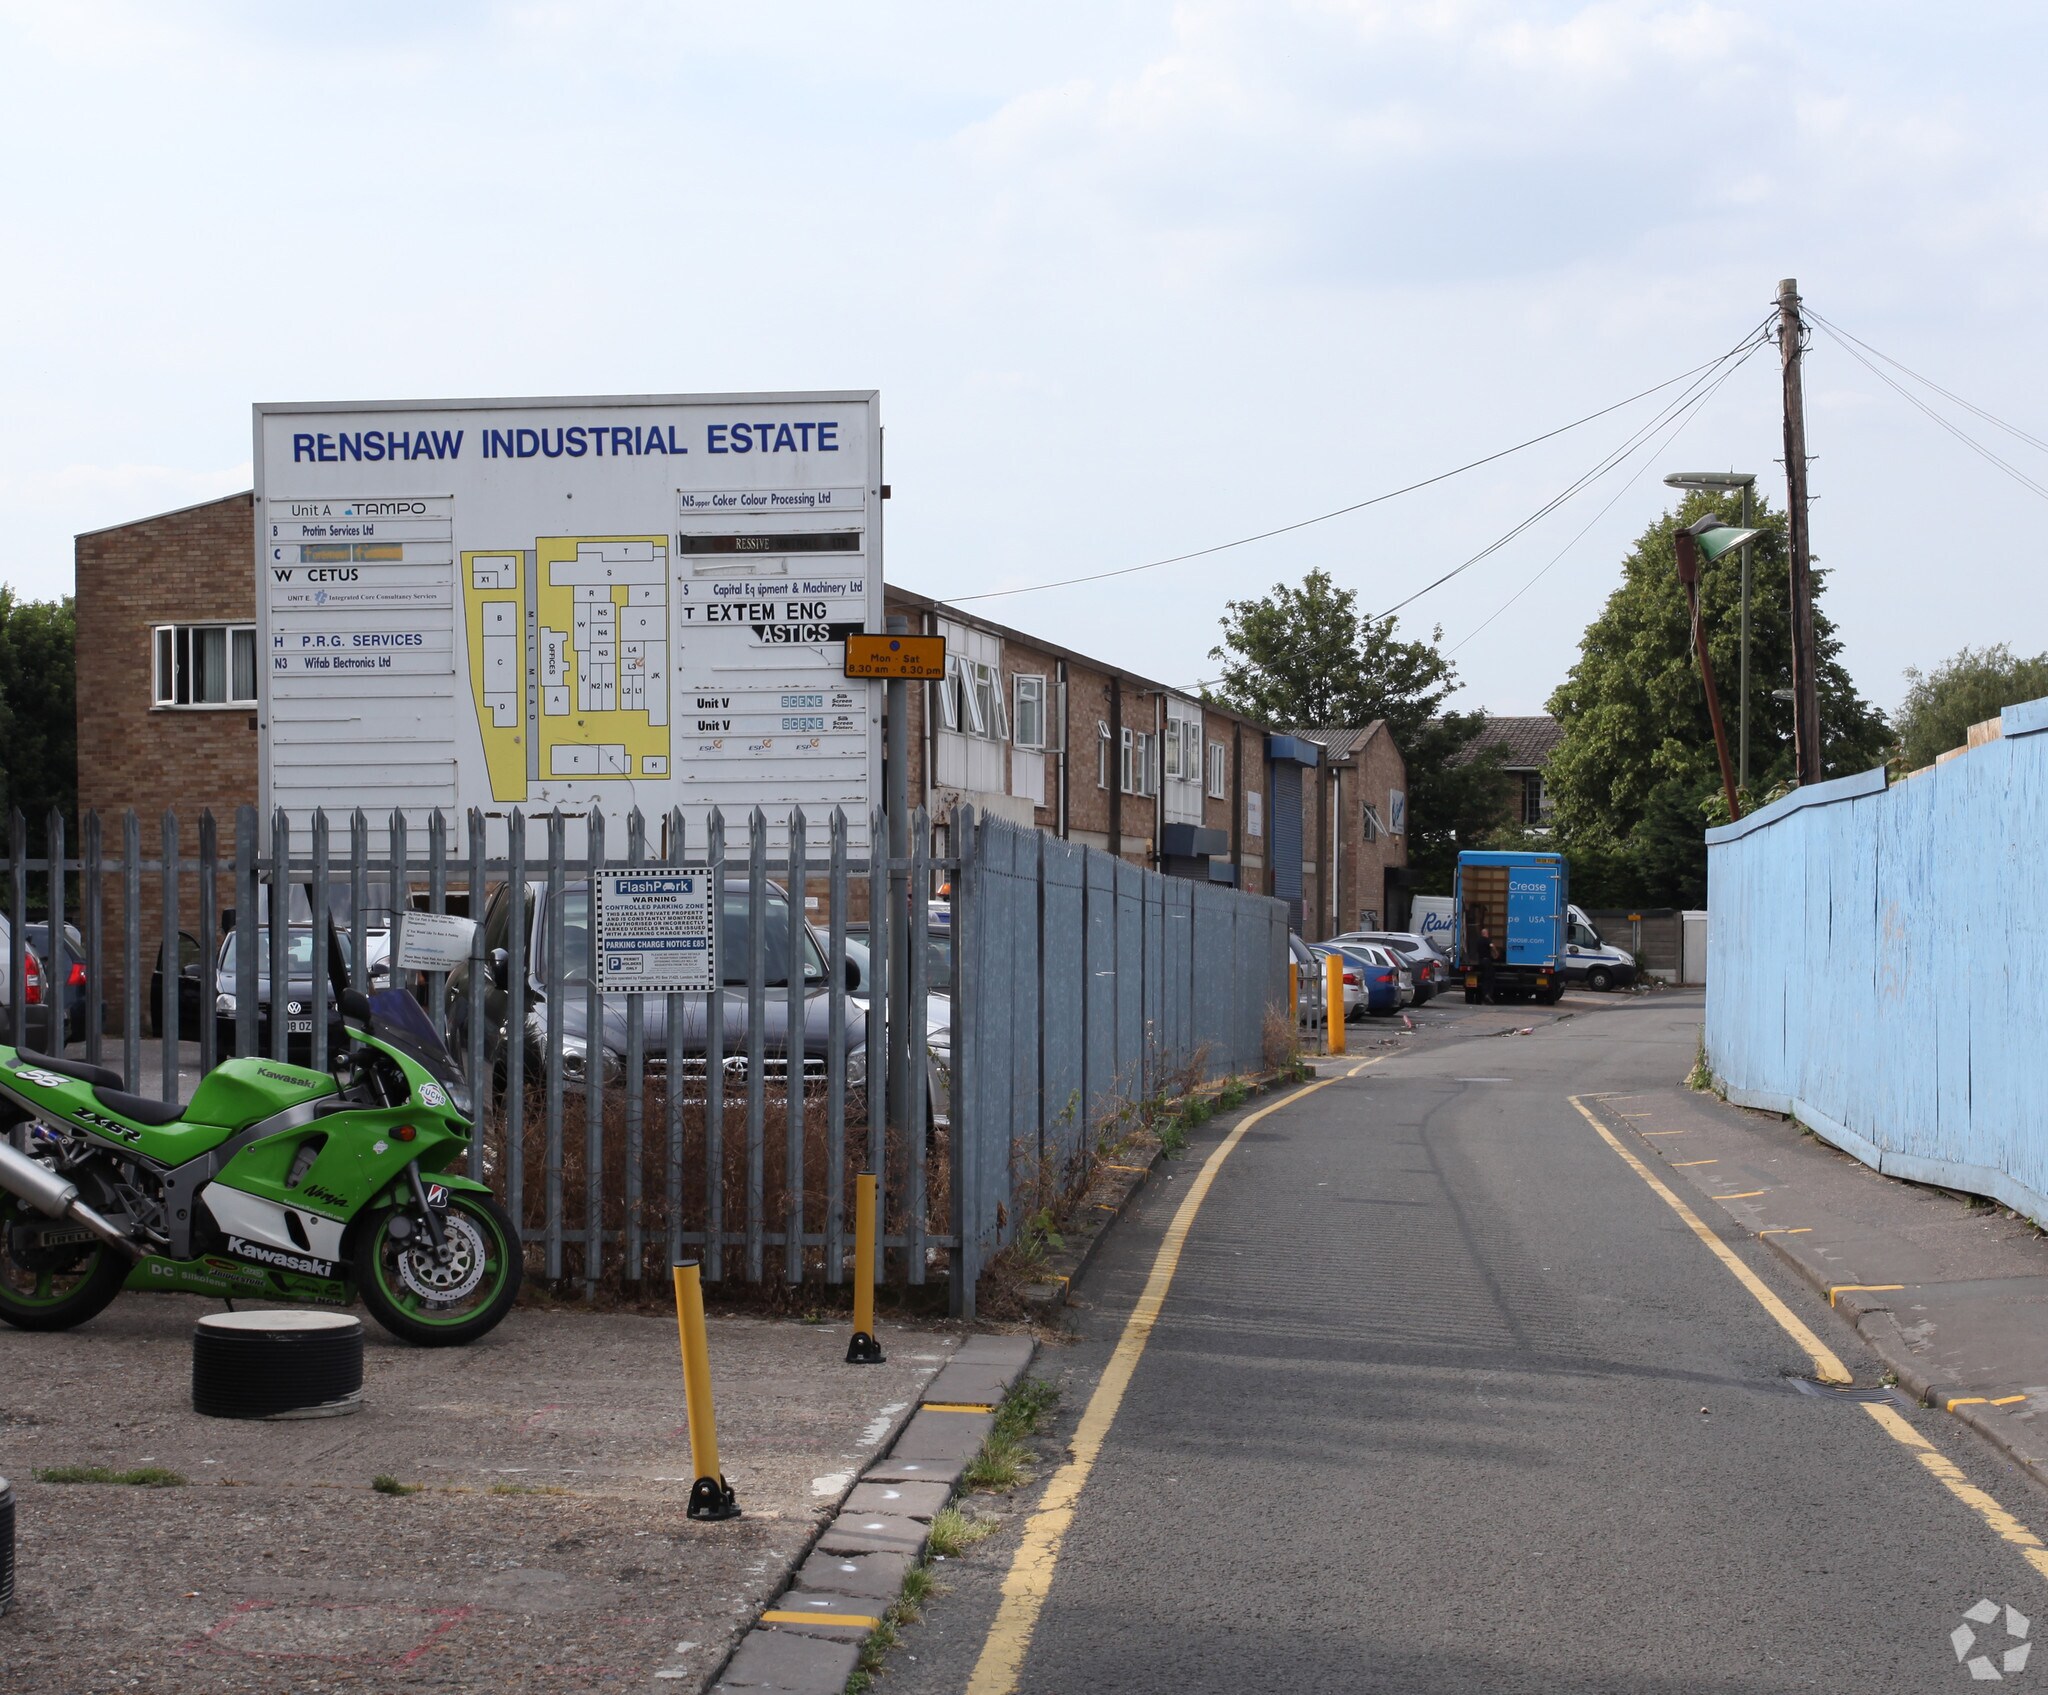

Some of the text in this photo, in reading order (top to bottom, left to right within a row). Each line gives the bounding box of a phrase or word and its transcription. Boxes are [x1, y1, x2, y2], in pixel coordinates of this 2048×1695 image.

[293, 422, 840, 462] RENSHAW INDUSTRIAL ESTATE
[712, 494, 737, 506] Coker
[741, 494, 767, 506] Colour
[771, 493, 815, 507] Processing
[818, 491, 831, 503] Ltd
[292, 505, 332, 516] Unit A
[352, 503, 426, 515] TAMPO
[273, 524, 374, 537] B Protim Services Ltd
[274, 549, 281, 560] C
[274, 568, 359, 582] W CETUS
[684, 583, 689, 596] S
[713, 583, 742, 598] Capital
[792, 582, 799, 593] &
[802, 582, 847, 596] Machinery
[850, 580, 863, 592] Ltd
[329, 594, 359, 602] Integrated
[376, 593, 412, 602] Consultancy
[684, 602, 827, 621] T EXTEM ENG
[761, 624, 830, 643] ASTICS
[274, 634, 423, 647] H P.R.G. SERVICES
[274, 656, 391, 669] N3 Wifab Electronics Ltd
[548, 643, 556, 675] OFFICES
[870, 654, 920, 663] Mon Sat
[848, 664, 872, 673] 8.30
[900, 666, 923, 674] 6.30
[926, 667, 941, 675] pm
[697, 698, 730, 709] Unit V
[781, 695, 823, 708] SCENE
[697, 720, 731, 731] Unit V
[782, 717, 824, 730] SCENE
[1508, 880, 1547, 892] Crease
[1528, 916, 1546, 924] USA
[606, 941, 636, 949] PARKING
[666, 940, 691, 948] NOTICE
[256, 1067, 317, 1089] Kawasaki
[419, 1086, 446, 1106] FUCHS
[303, 1184, 349, 1207] Ninja
[227, 1236, 332, 1278] Kawasaki
[151, 1263, 174, 1278] DC
[182, 1271, 227, 1288] Silkolene
